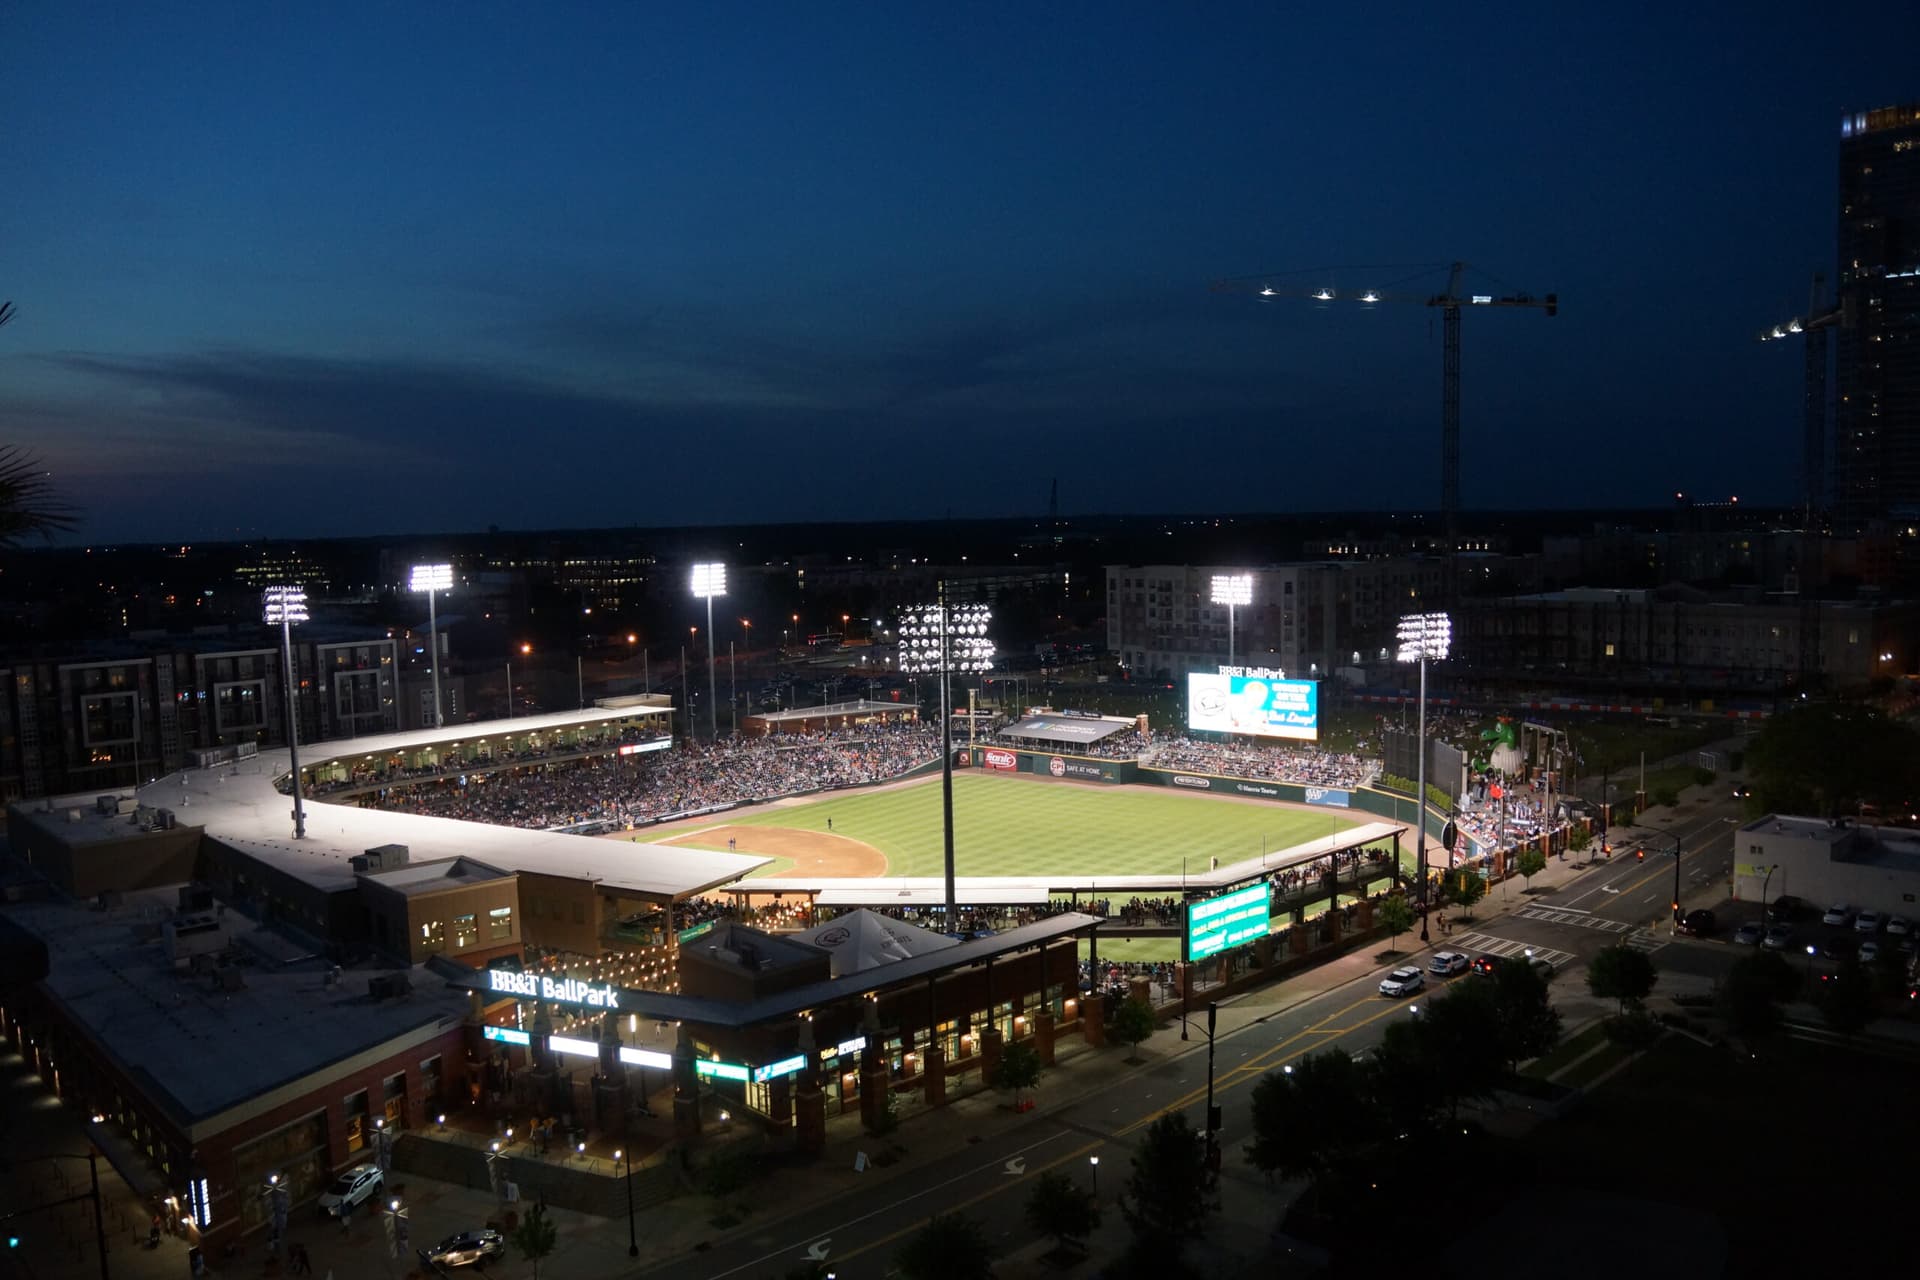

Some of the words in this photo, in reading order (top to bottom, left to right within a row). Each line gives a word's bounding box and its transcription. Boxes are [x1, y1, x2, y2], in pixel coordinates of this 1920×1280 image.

[1219, 665, 1245, 677] BB&T
[1246, 667, 1285, 680] BallPark
[1243, 785, 1260, 793] Harris
[489, 969, 540, 996] BB&T
[542, 976, 619, 1008] BallPark
